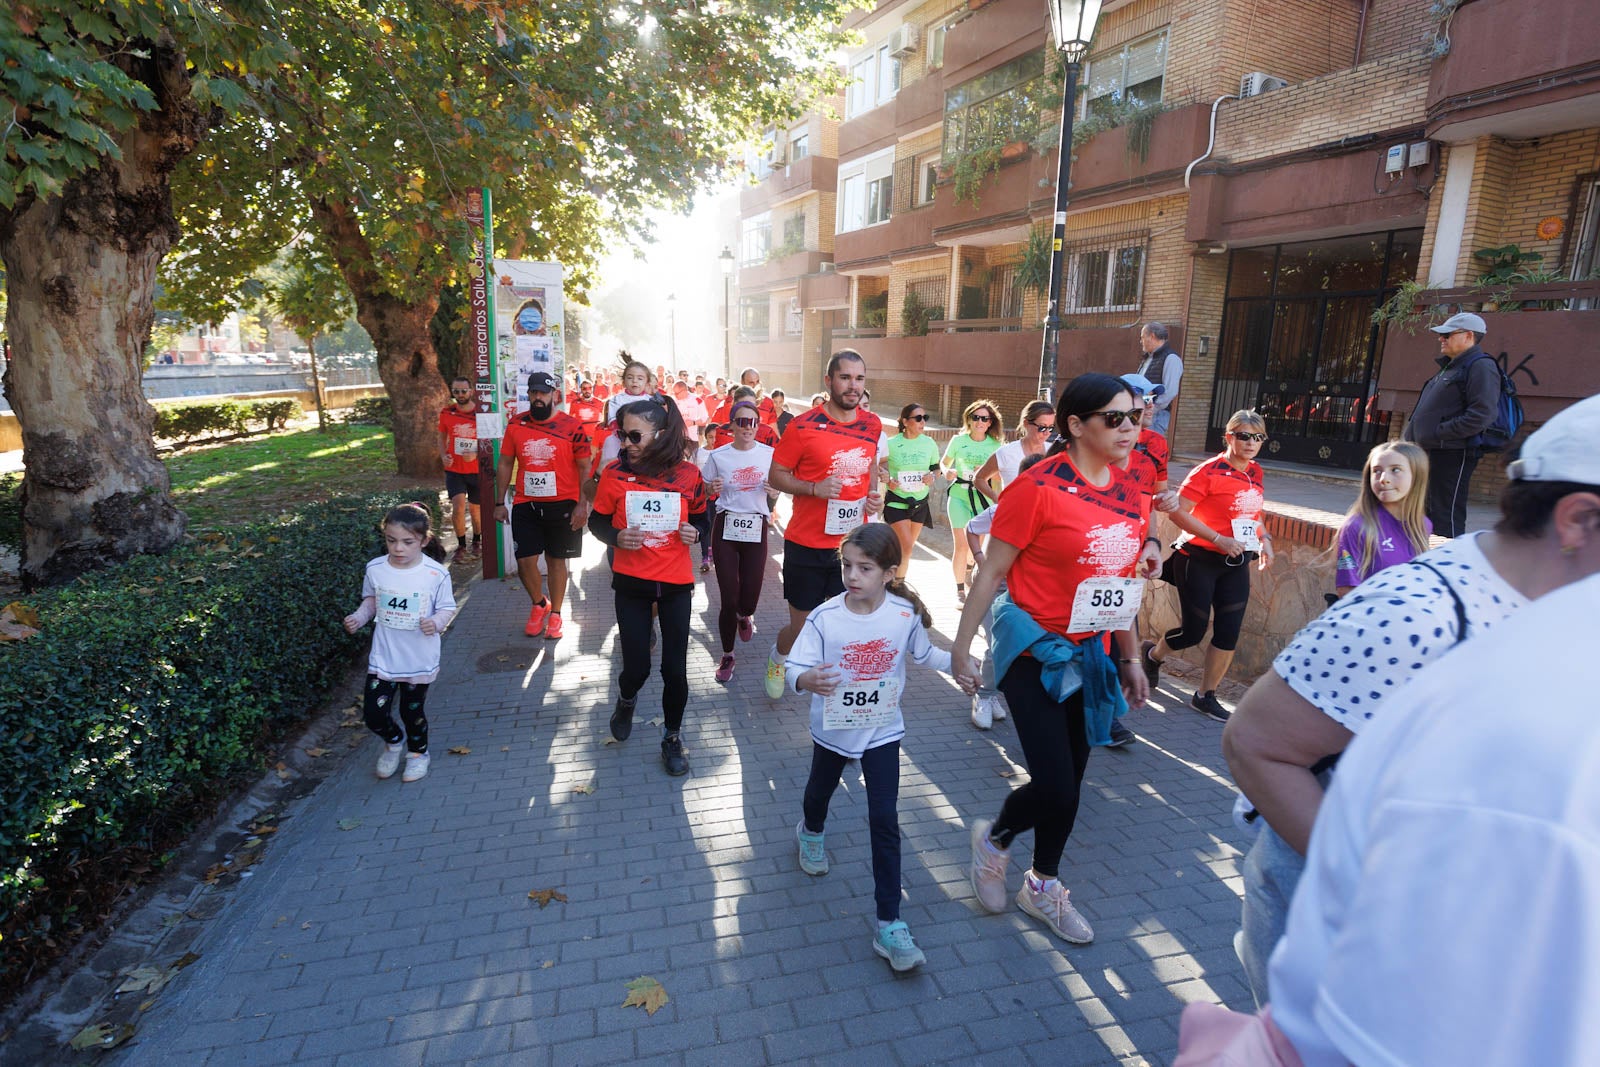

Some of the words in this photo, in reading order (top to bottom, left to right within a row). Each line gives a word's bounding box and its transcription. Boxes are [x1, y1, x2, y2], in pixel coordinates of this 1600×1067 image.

[1321, 275, 1330, 289] 2
[529, 477, 546, 485] 324
[643, 500, 661, 512] 43
[838, 507, 858, 518] 906
[733, 519, 753, 529] 662
[1089, 540, 1139, 553] carrera
[388, 597, 408, 610] 44
[1091, 589, 1124, 607] 583
[844, 652, 893, 662] carrera
[842, 690, 879, 706] 584
